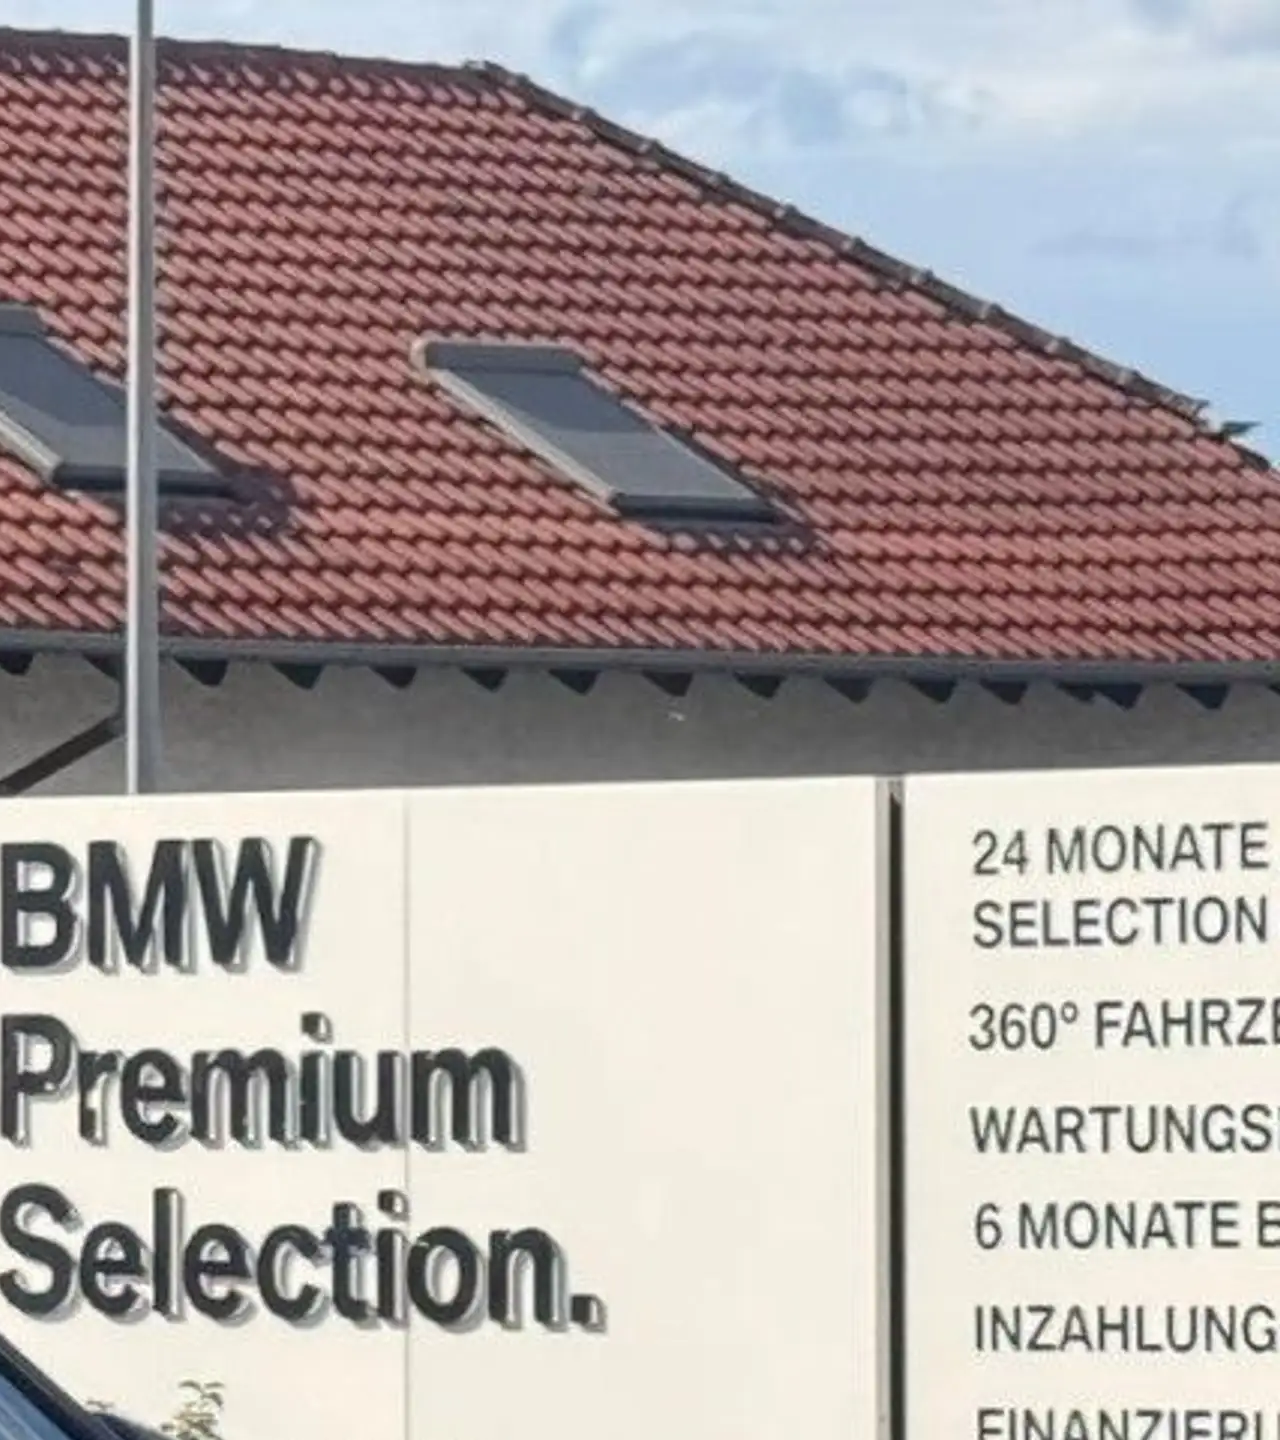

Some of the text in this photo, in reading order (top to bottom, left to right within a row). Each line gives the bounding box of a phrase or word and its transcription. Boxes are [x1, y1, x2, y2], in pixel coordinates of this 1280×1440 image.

[972, 821, 1270, 876] 24 MONATE
[0, 836, 320, 974] BMW
[972, 895, 1268, 949] SELECTION
[968, 996, 1280, 1051] 360° FAHRZ
[969, 1102, 1280, 1154] WARTUNGS
[975, 1203, 1003, 1250] 6
[1018, 1200, 1241, 1250] MONATE
[975, 1303, 1277, 1353] INZAHLUNG
